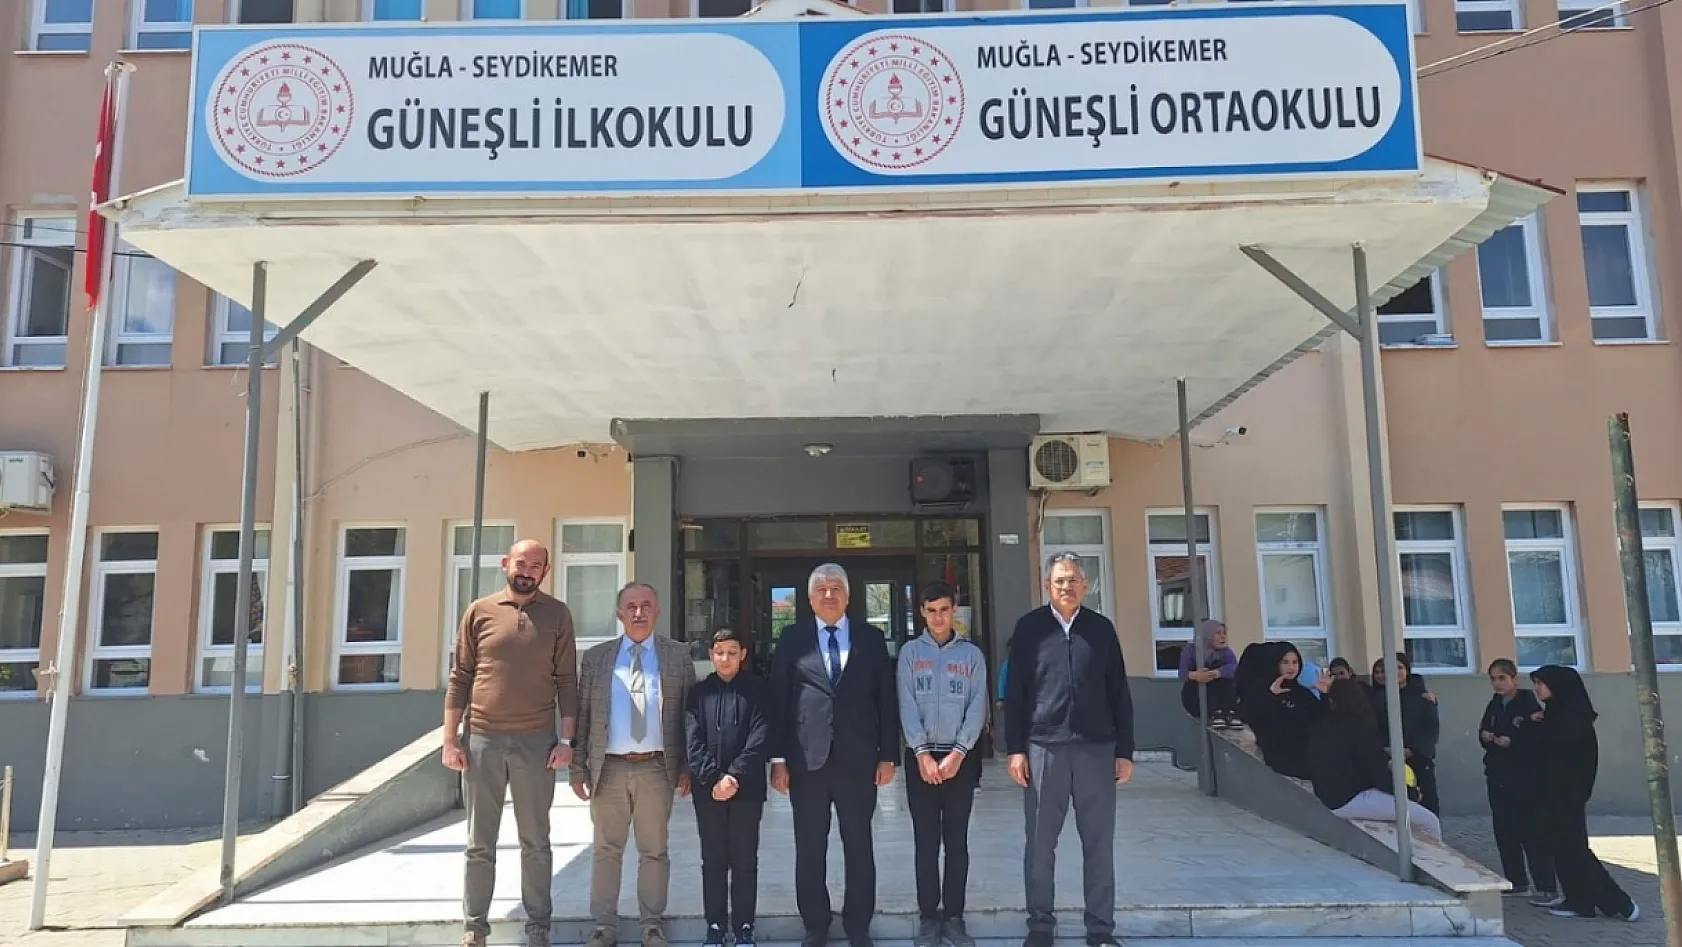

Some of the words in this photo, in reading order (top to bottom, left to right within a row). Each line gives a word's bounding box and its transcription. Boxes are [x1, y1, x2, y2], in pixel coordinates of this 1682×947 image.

[368, 52, 453, 79] MUĞLA
[473, 51, 617, 78] SEYDİKEMER
[977, 40, 1062, 69] MUĞLA
[1080, 36, 1228, 66] SEYDİKEMER
[367, 98, 540, 161] GÜNEŞLİ
[554, 98, 752, 149] İLKOKULU
[979, 84, 1139, 148] GÜNEŞLİ
[1151, 86, 1381, 134] ORTAOKULU
[916, 675, 932, 691] NY
